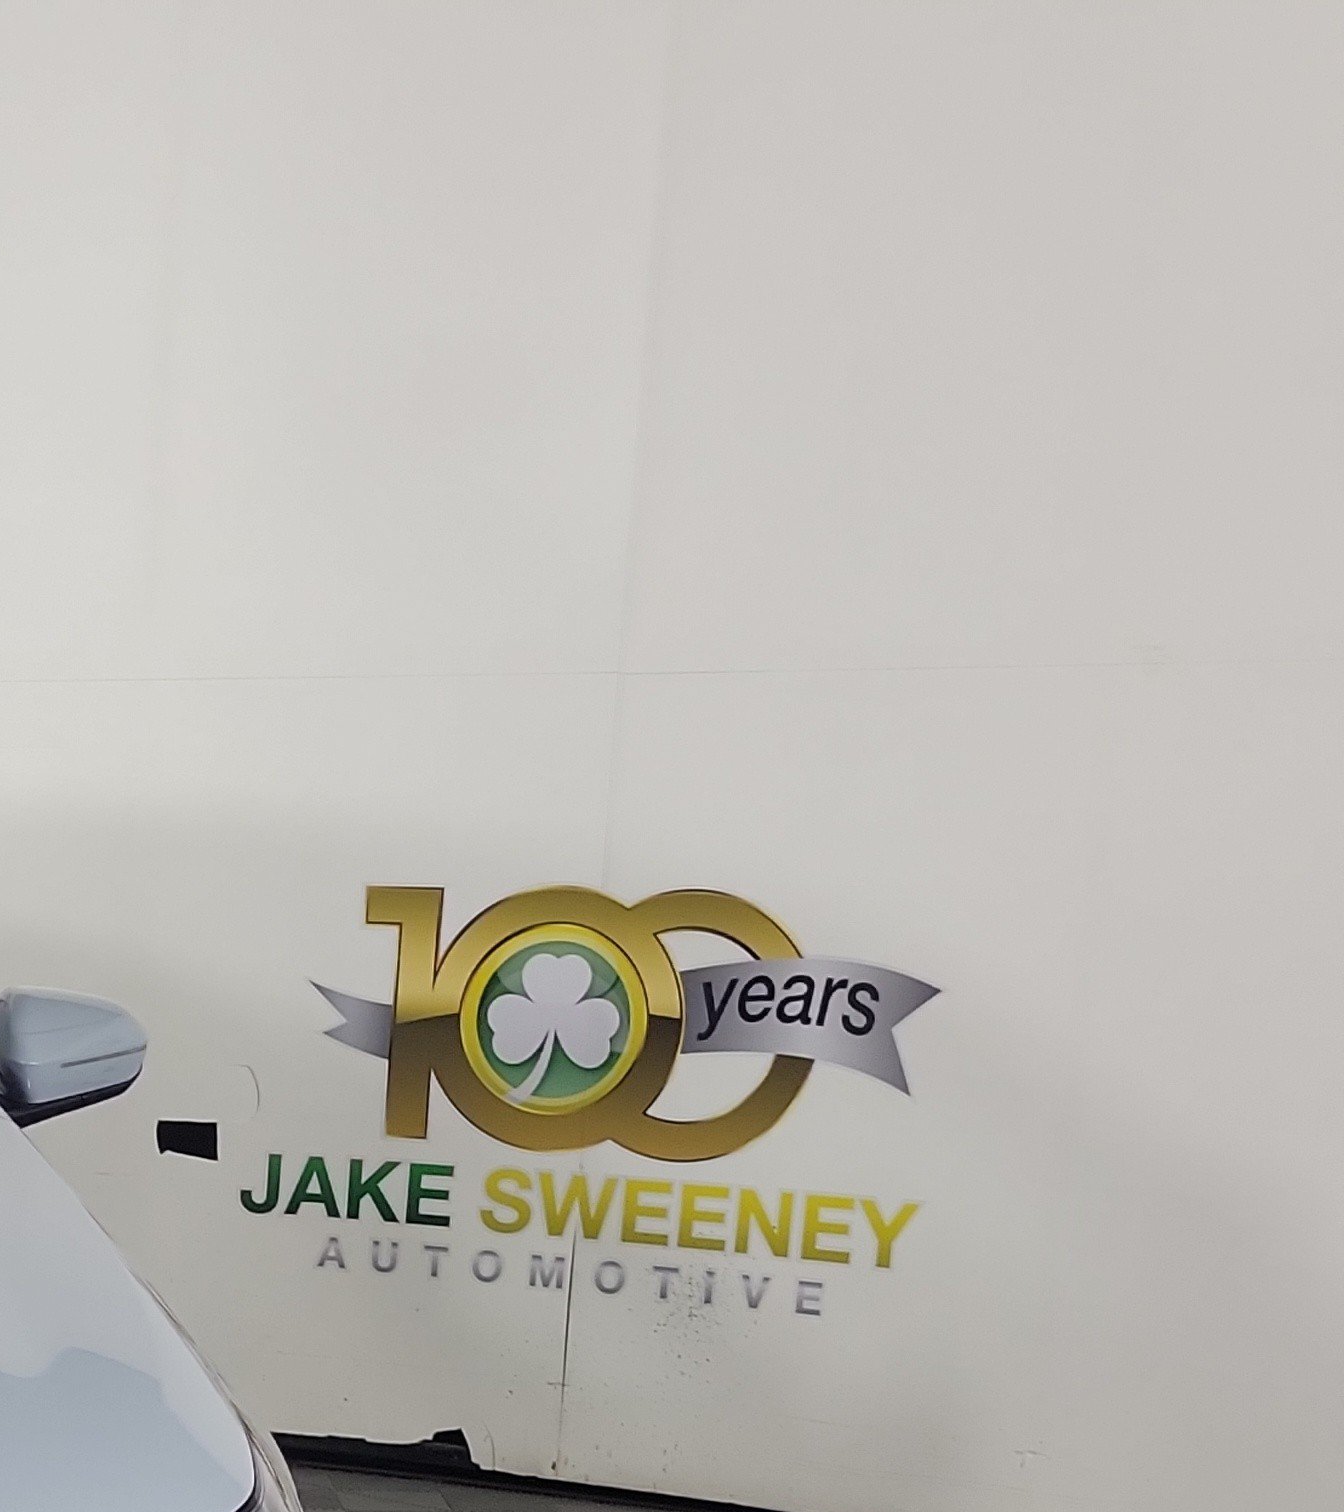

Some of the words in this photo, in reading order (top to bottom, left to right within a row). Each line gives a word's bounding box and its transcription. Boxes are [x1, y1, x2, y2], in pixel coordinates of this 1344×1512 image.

[365, 884, 815, 1163] 100
[696, 972, 881, 1041] years
[239, 1152, 456, 1228] JAKE
[479, 1168, 921, 1269] SWEENEY
[316, 1236, 824, 1316] AUTOMOTIVE
